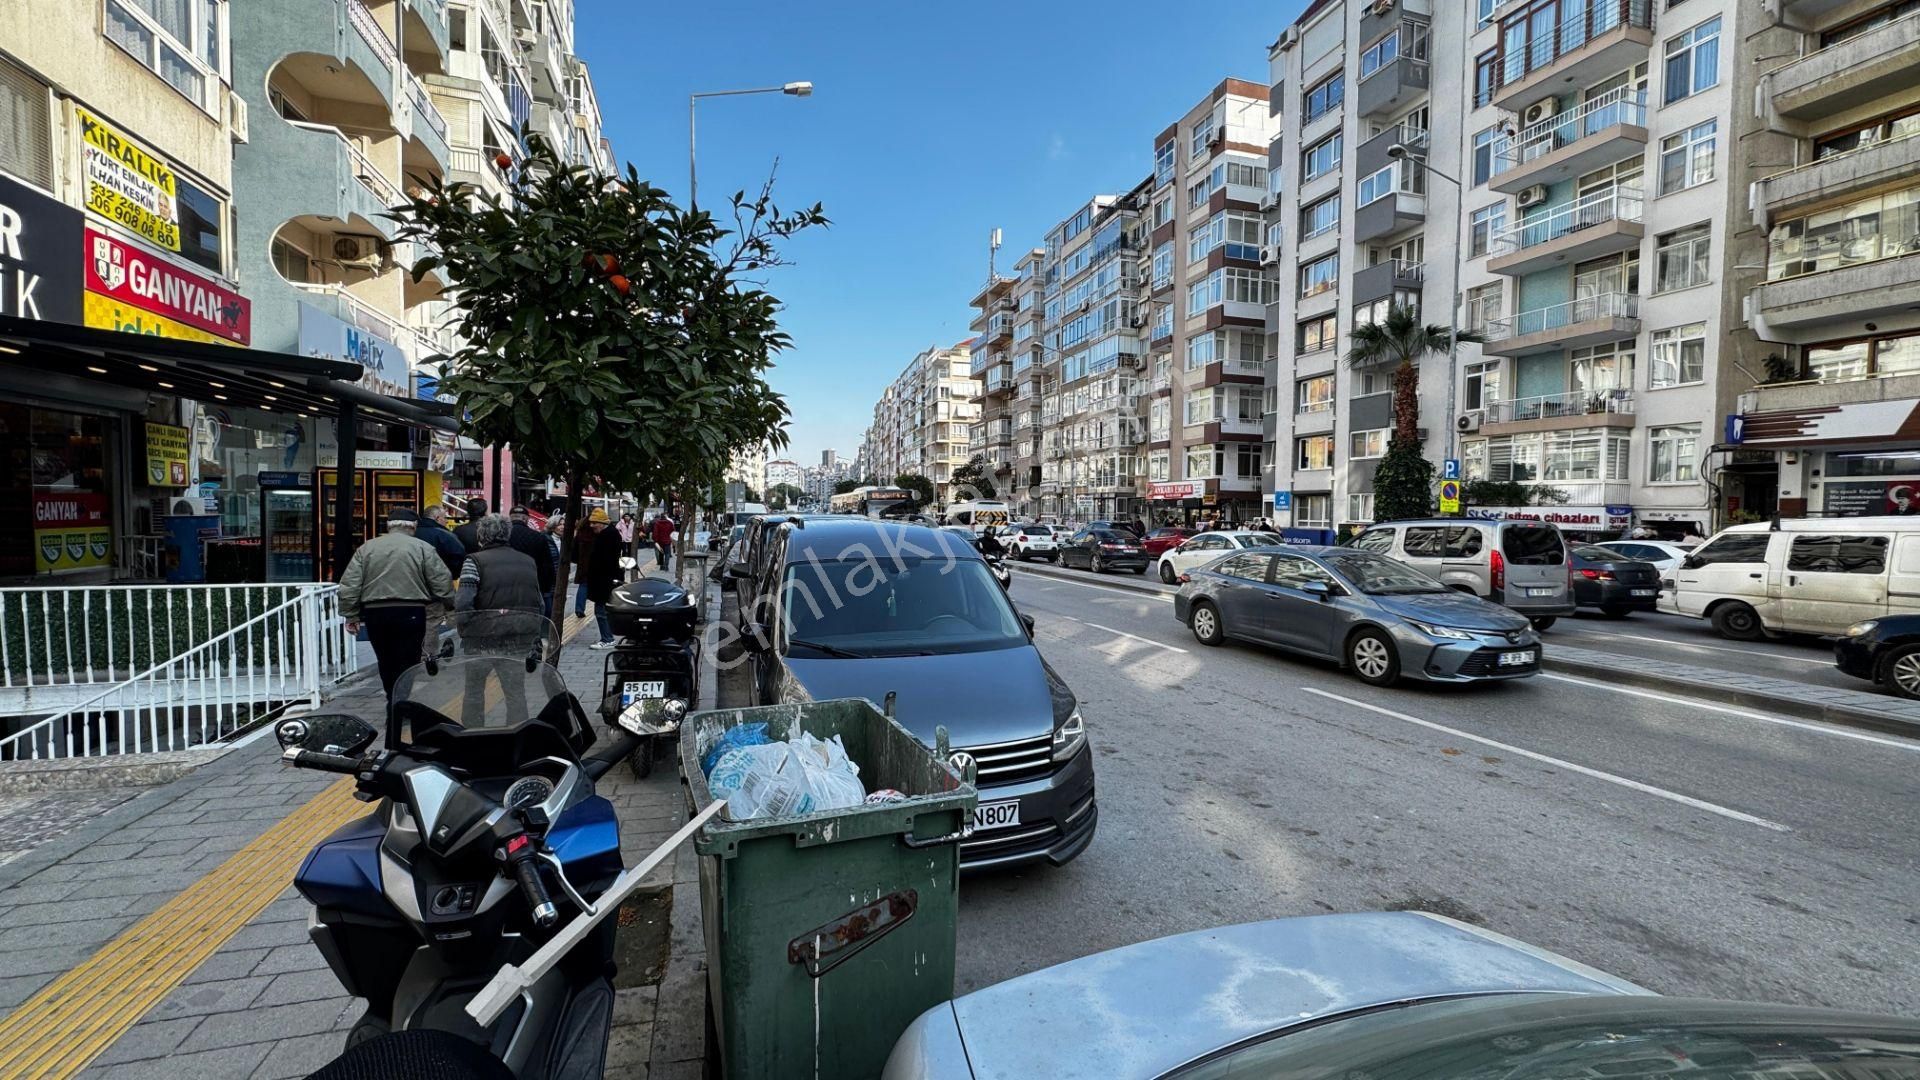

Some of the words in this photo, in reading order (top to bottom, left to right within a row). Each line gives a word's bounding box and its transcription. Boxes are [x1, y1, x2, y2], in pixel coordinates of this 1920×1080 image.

[91, 148, 119, 174] YURT
[122, 168, 154, 196] EMLAK
[90, 180, 115, 201] 232
[119, 197, 142, 216] 246
[159, 220, 174, 234] 19
[114, 206, 138, 230] 908
[141, 221, 154, 238] 08
[157, 230, 175, 247] 80
[129, 258, 222, 325] GANYAN
[346, 327, 384, 373] Helix
[1445, 461, 1455, 478] P
[36, 501, 78, 521] GANYAN
[625, 683, 639, 692] 35
[642, 682, 662, 692] CIY
